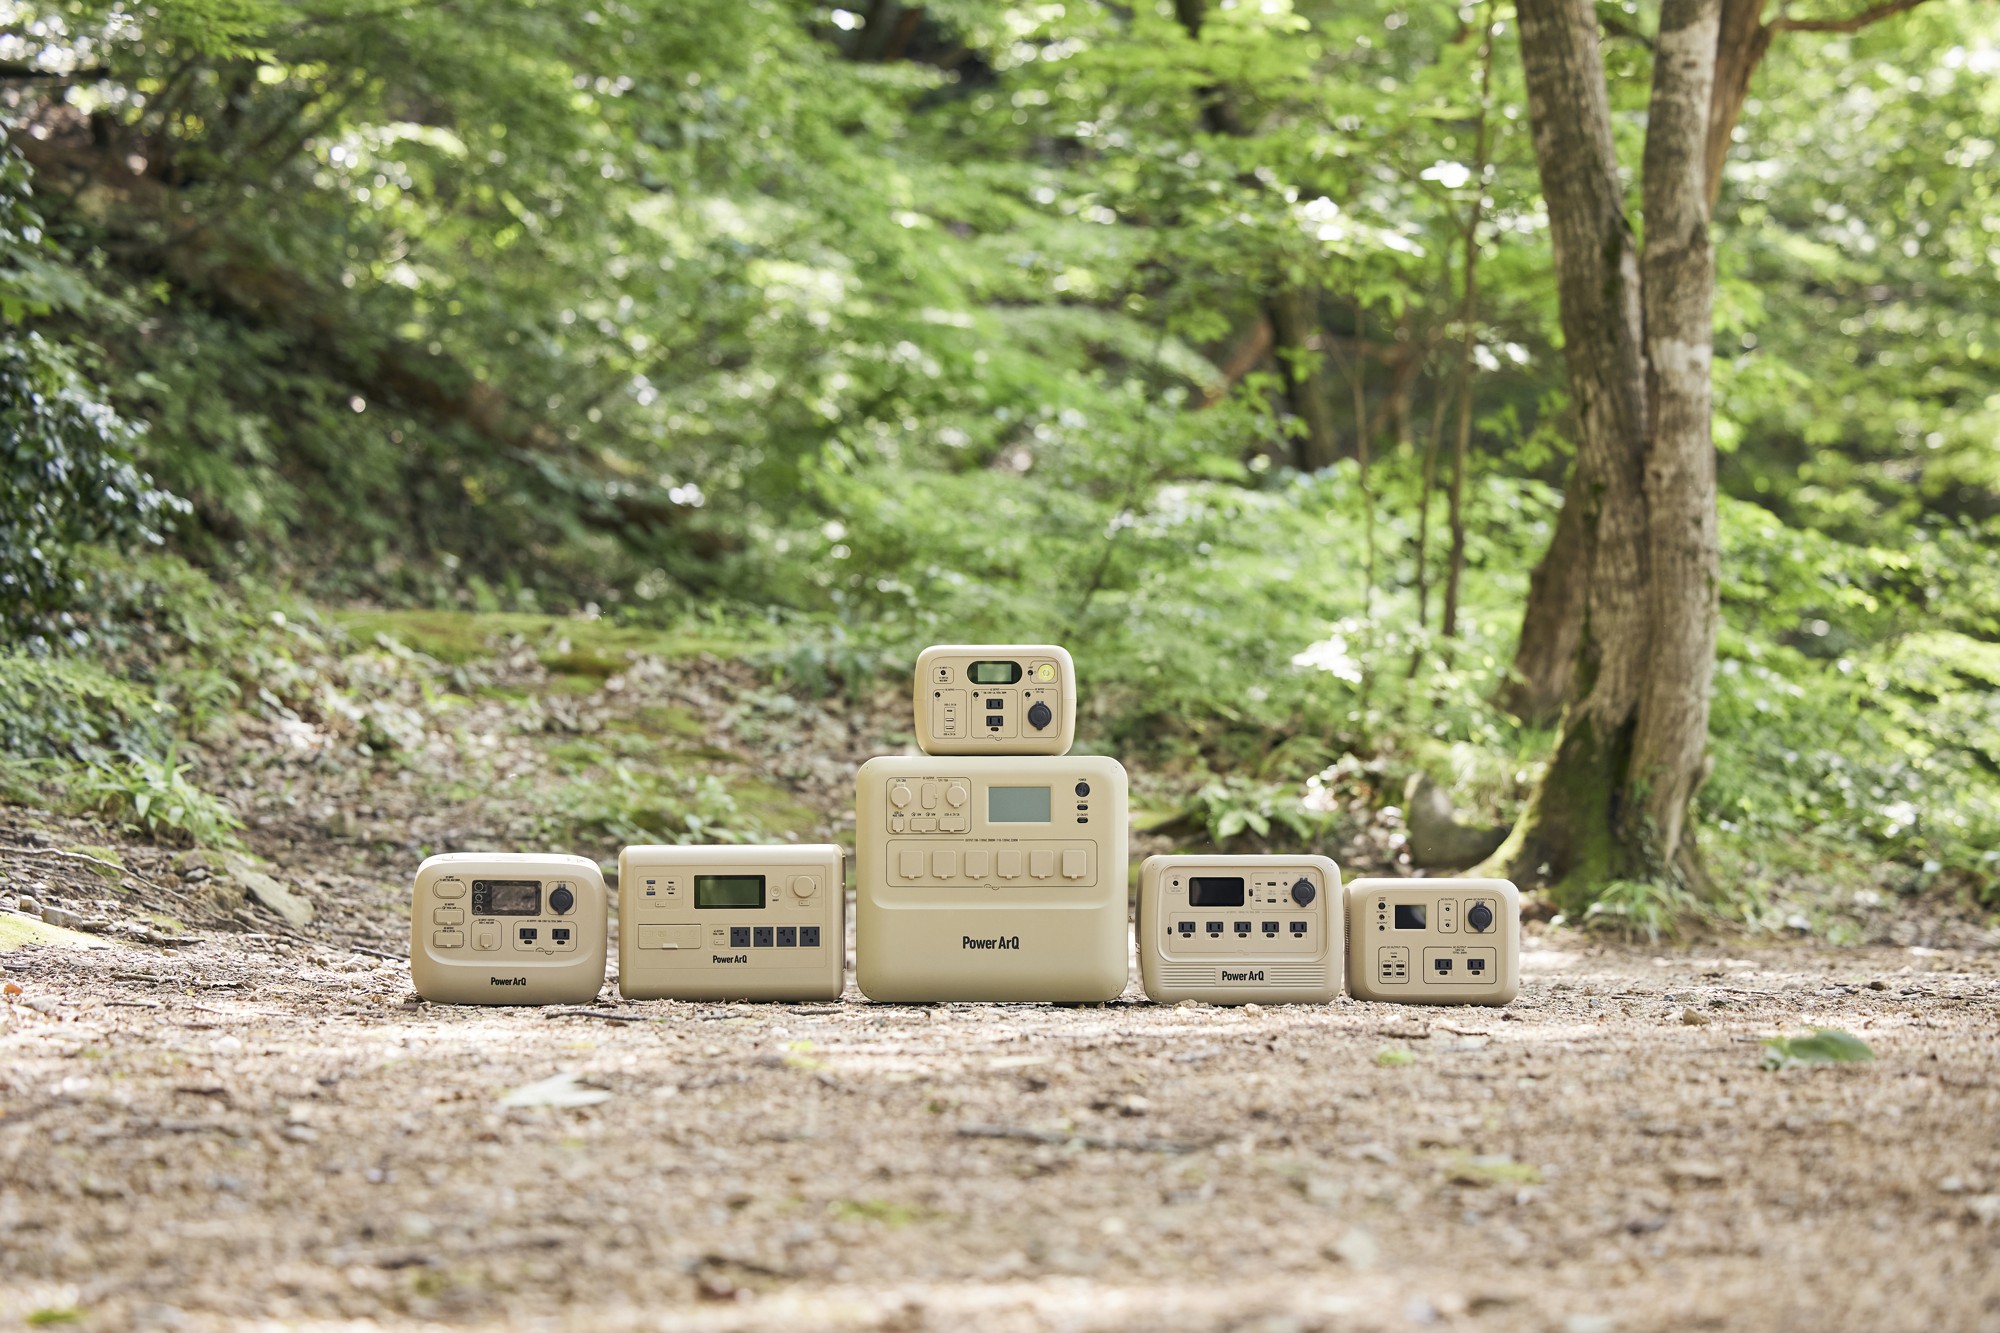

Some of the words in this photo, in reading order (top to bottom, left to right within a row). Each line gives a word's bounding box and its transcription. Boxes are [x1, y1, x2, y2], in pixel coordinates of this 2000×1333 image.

[963, 936, 997, 949] Power
[998, 936, 1019, 949] ArQ
[713, 955, 733, 963] Power
[734, 955, 747, 963] ArQ
[1222, 971, 1247, 981] Power
[1248, 971, 1264, 981] ArQ
[491, 977, 512, 985] Power
[513, 977, 526, 985] ArQ
